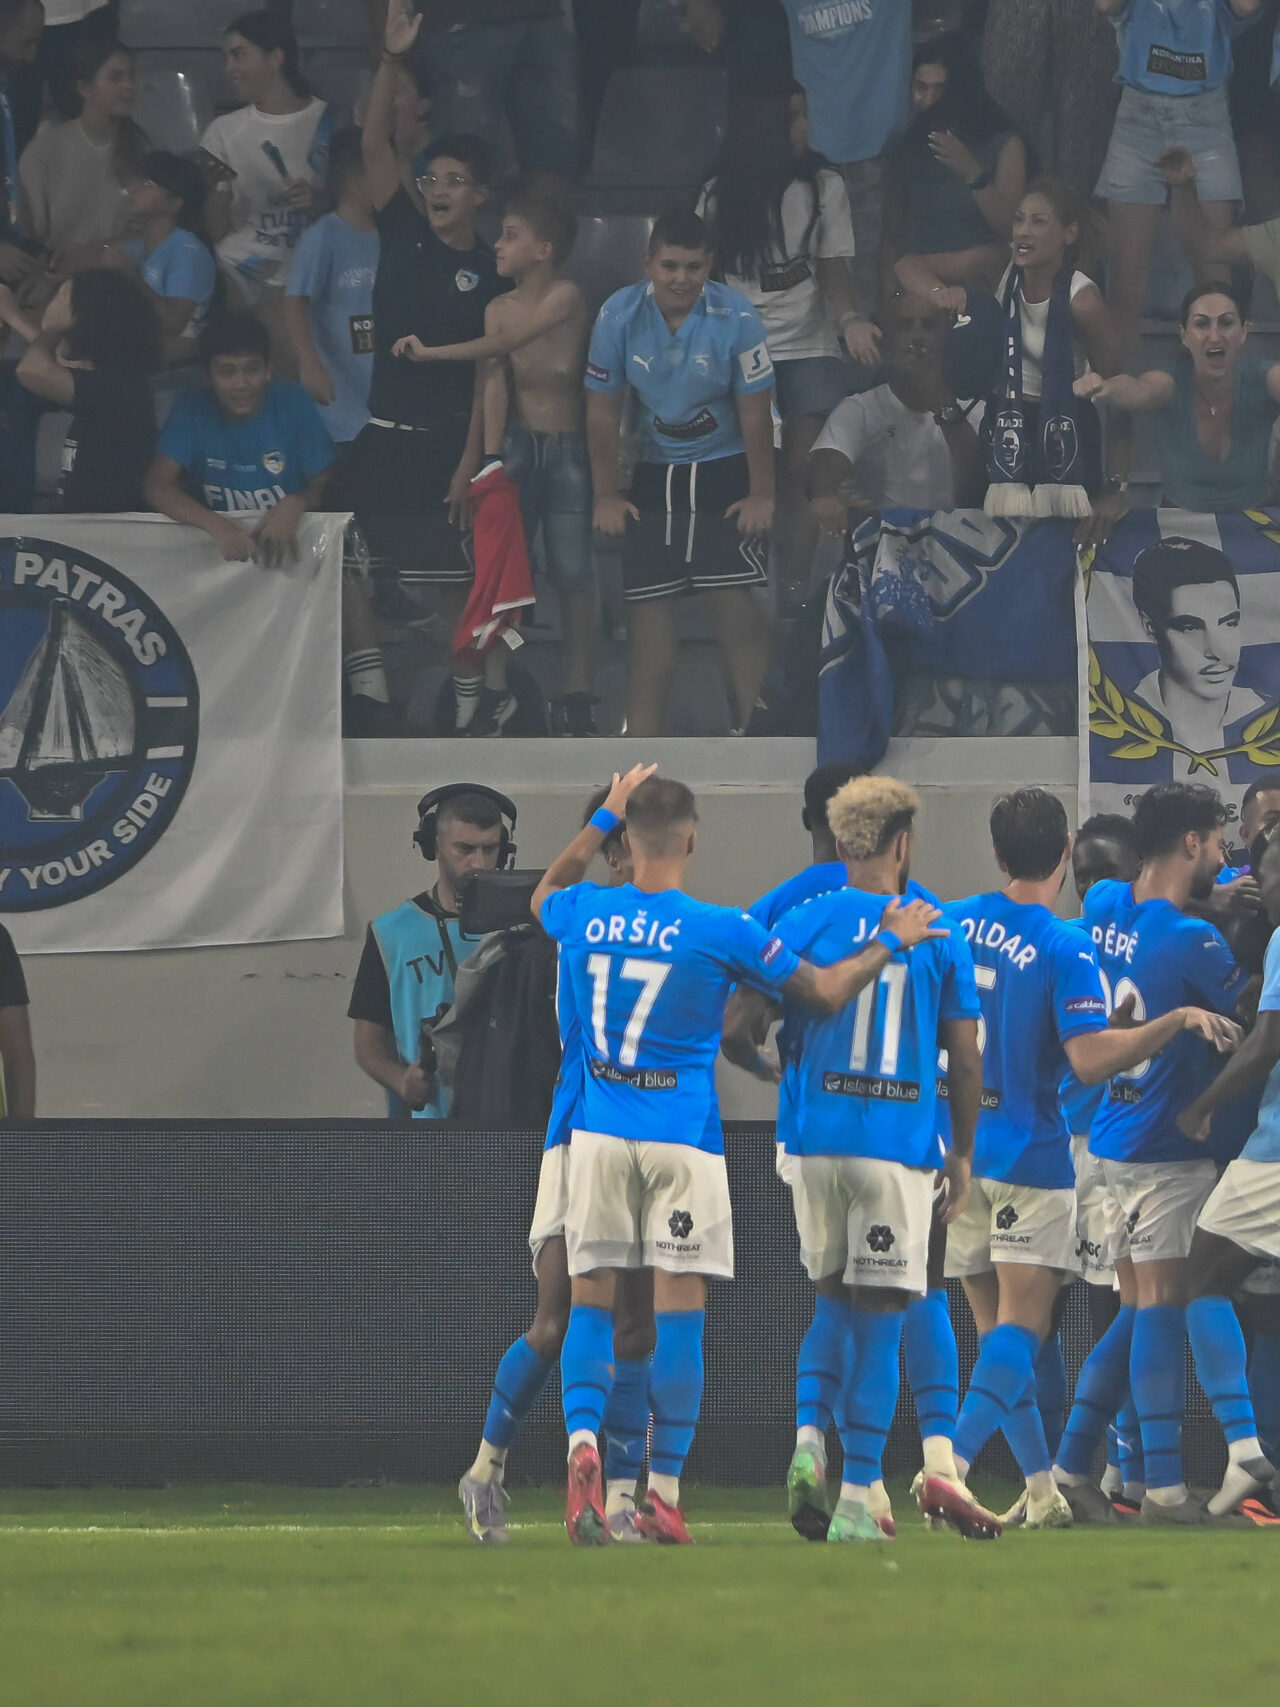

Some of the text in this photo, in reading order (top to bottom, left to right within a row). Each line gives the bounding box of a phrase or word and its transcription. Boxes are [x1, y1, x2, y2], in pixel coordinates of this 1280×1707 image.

[798, 0, 873, 34] AMPIONS
[13, 552, 167, 666] PATRAS
[20, 839, 115, 890] YOUR
[113, 772, 173, 844] SIDE
[585, 910, 682, 952] ORŠIĆ
[961, 918, 1037, 971] OLDAR
[1092, 922, 1139, 964] PÊPÊ
[406, 950, 444, 984] TV
[587, 953, 673, 1067] 17
[849, 963, 908, 1075] 11
[645, 1069, 676, 1087] blue
[843, 1078, 882, 1096] island
[886, 1081, 919, 1099] blue
[980, 1093, 999, 1107] ue
[990, 1234, 1032, 1244] THREAT
[852, 1256, 908, 1267] NOTHREAT
